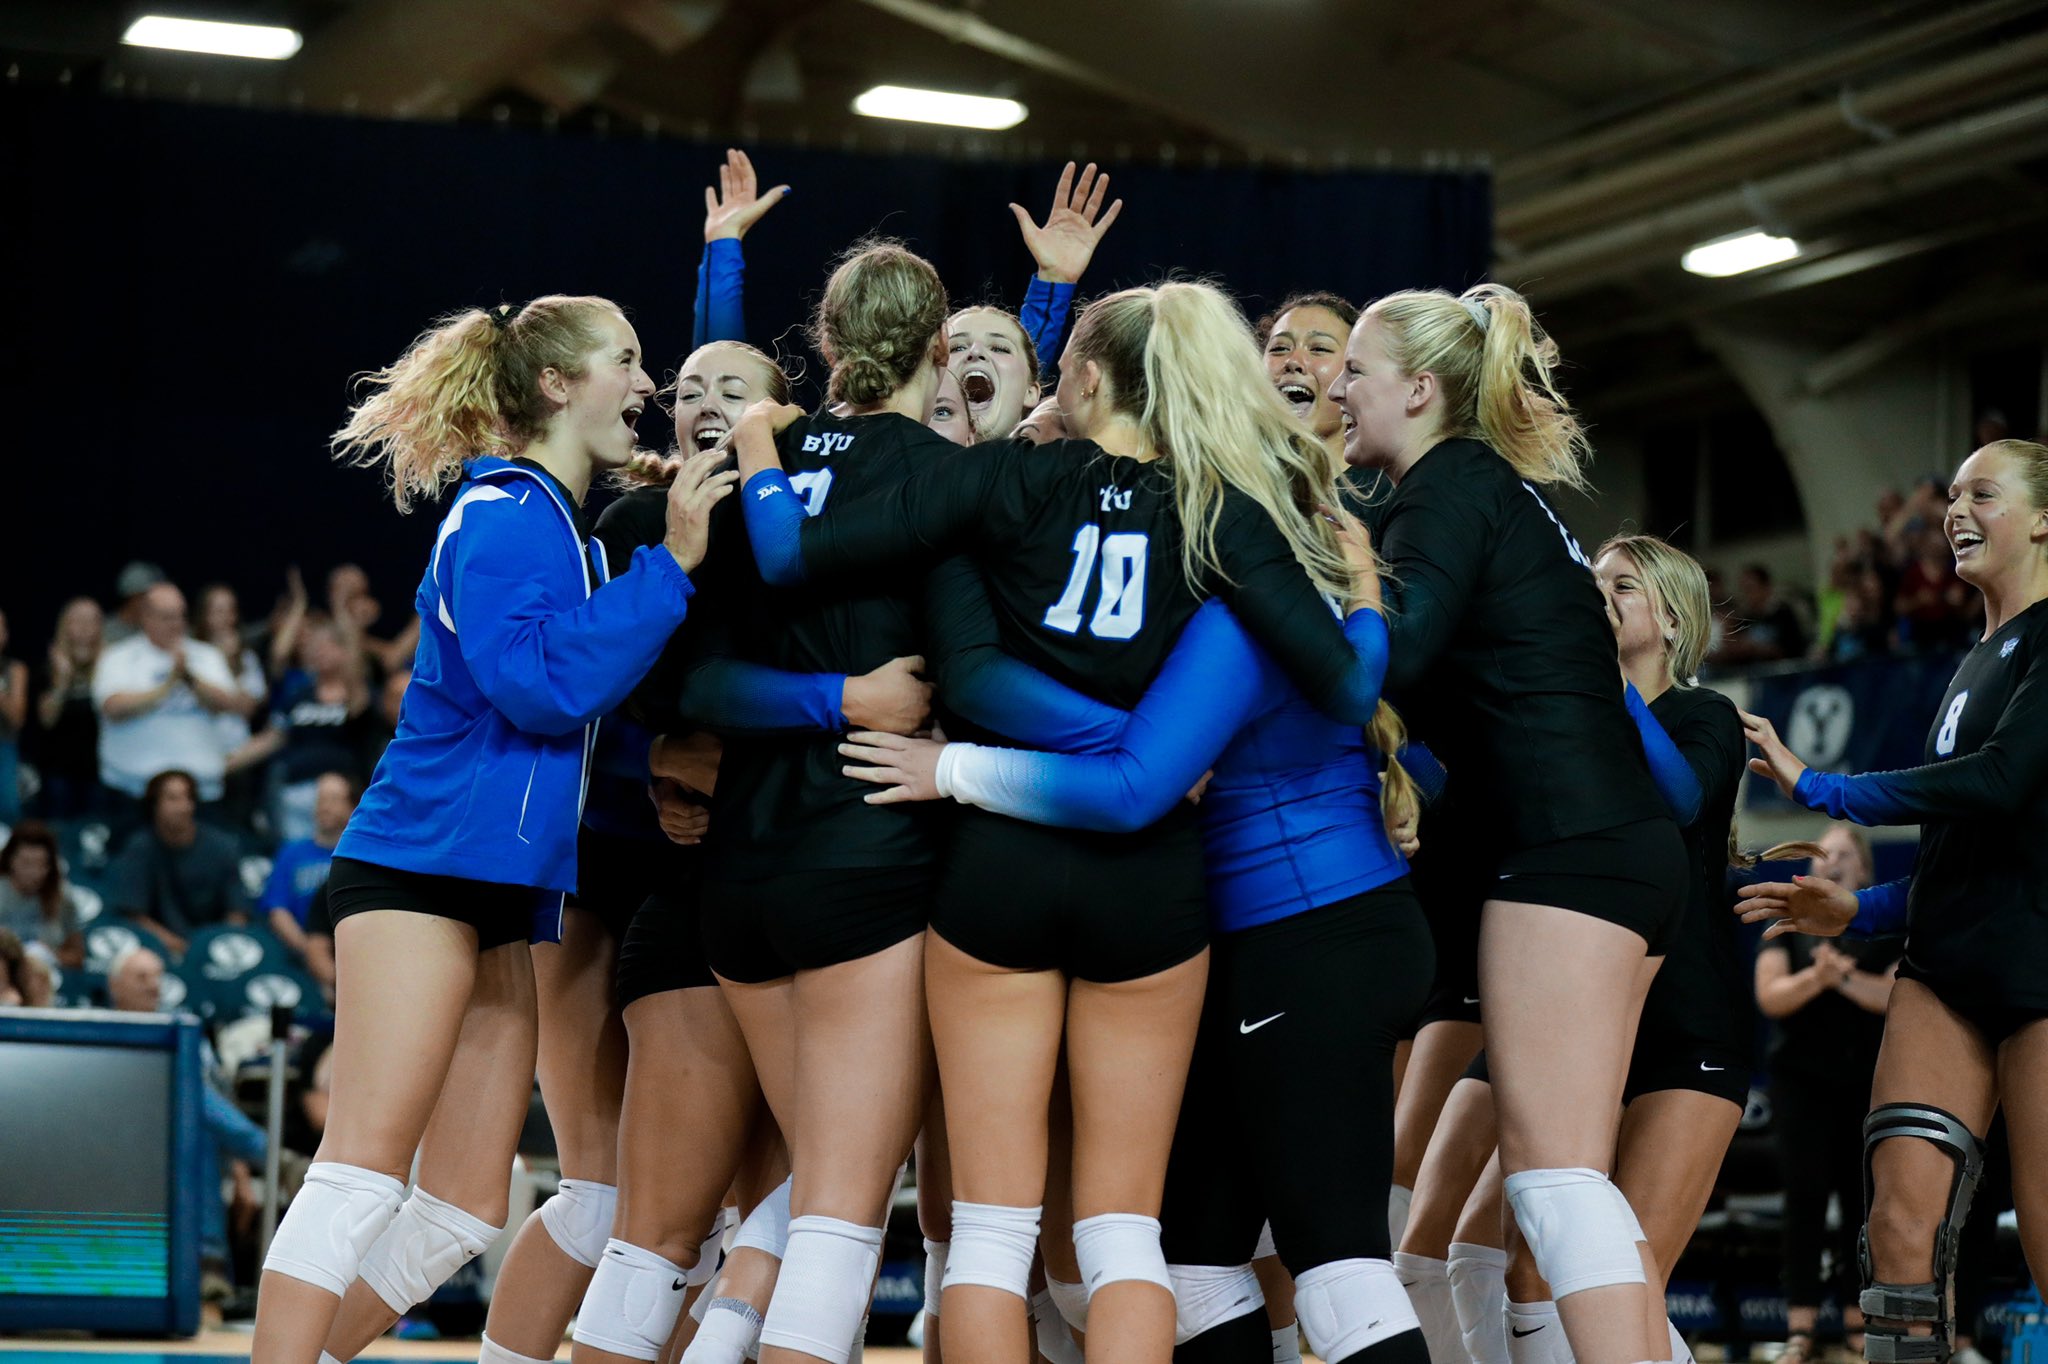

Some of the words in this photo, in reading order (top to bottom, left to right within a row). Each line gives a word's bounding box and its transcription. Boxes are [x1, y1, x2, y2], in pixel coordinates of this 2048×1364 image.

[801, 432, 855, 456] BYU
[1099, 484, 1132, 512] YU
[1041, 521, 1150, 642] 10
[1935, 689, 1970, 757] 8
